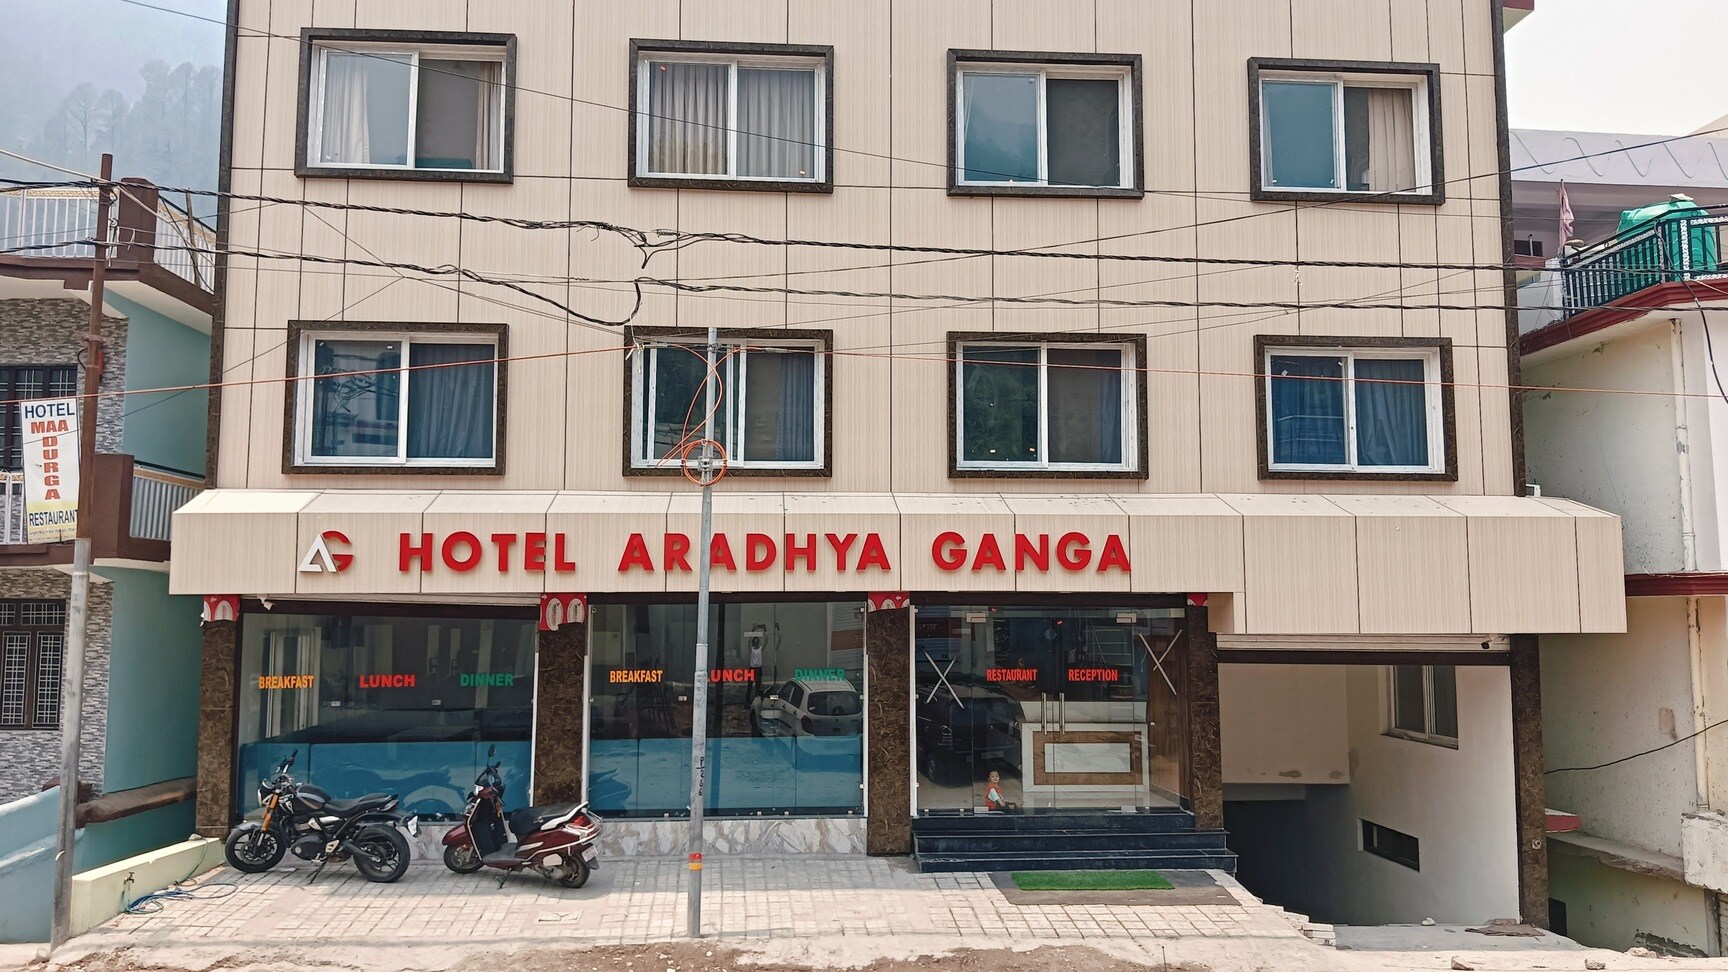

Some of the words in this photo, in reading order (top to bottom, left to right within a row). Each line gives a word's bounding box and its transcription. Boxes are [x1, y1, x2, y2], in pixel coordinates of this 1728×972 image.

[25, 402, 75, 419] HOTEL
[30, 420, 69, 434] MAA
[42, 436, 61, 500] DURGA
[399, 531, 576, 572] HOTEL
[618, 532, 892, 572] ARADHYA
[931, 531, 1132, 572] GANGA
[258, 675, 315, 689] BREAKFAST
[359, 674, 416, 689] LUNCH
[460, 673, 514, 687] DINNER
[609, 669, 663, 684] BREAKFAST
[706, 669, 755, 683] UNCH
[794, 668, 846, 682] DINNER
[986, 668, 1037, 682] RESTAURANT
[1068, 668, 1118, 682] RECEPTION
